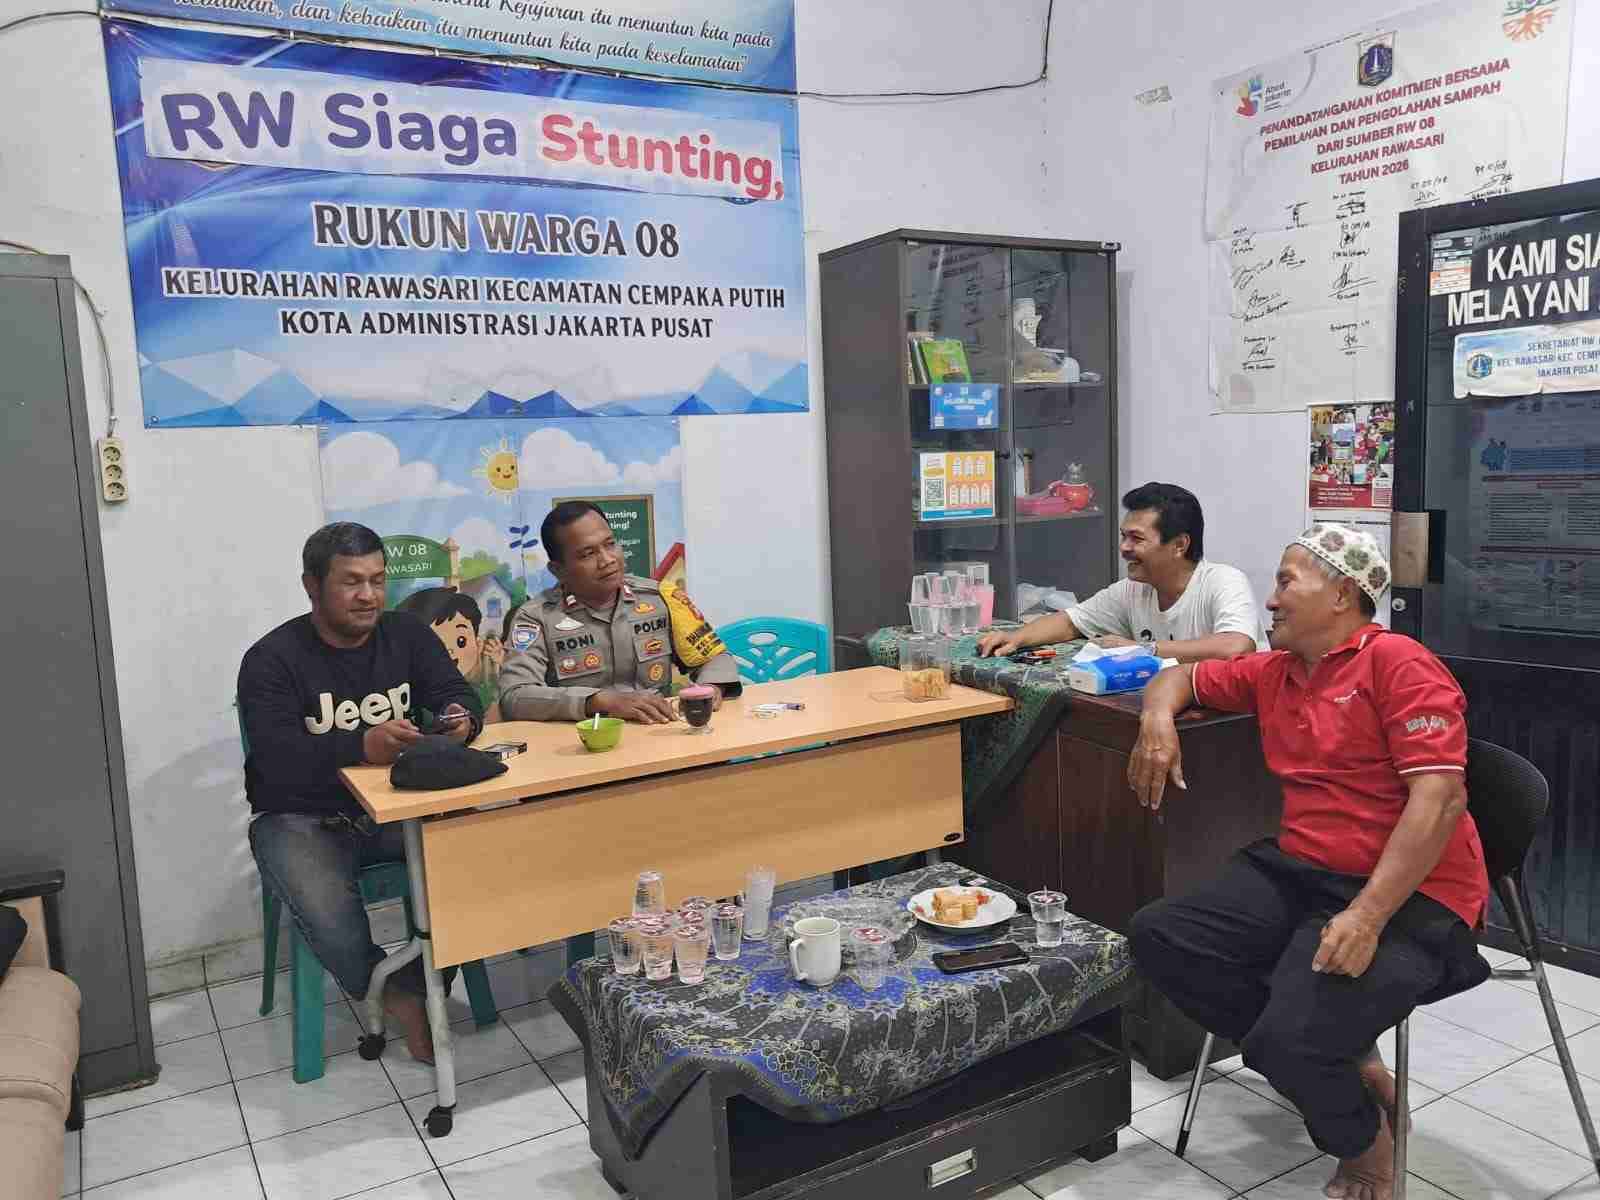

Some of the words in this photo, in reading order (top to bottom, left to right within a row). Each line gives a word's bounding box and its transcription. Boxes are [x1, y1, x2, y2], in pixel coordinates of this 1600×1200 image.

[291, 2, 332, 21] dan
[336, 2, 428, 32] kebaikan
[434, 17, 459, 37] itu
[466, 24, 552, 49] menuntun
[559, 31, 592, 53] kita
[595, 41, 639, 60] pada
[590, 7, 612, 26] itu
[617, 14, 696, 37] menuntun
[699, 18, 730, 41] kita
[732, 30, 772, 48] pada
[1260, 94, 1373, 137] PENANDATANGANAN
[1375, 76, 1442, 104] KOMITMEN
[1444, 57, 1511, 86] BERSAMA
[1264, 125, 1328, 152] PEMILAHAN
[1330, 116, 1356, 134] DAN
[1357, 95, 1442, 127] PENGOLAHAN
[1443, 79, 1502, 106] SAMPAH
[160, 89, 296, 152] RW
[323, 92, 518, 166] Siaga
[541, 113, 785, 200] Stunting,
[1311, 148, 1380, 175] KELURAHAN
[1381, 133, 1445, 159] RAWASARI
[1316, 139, 1344, 155] DARI
[1345, 126, 1395, 148] SUMBER
[1395, 120, 1417, 136] RW
[1418, 116, 1436, 131] 08
[1339, 167, 1380, 185] TAHUN
[1381, 159, 1410, 177] 2026
[313, 203, 469, 250] RUKUN
[478, 211, 627, 257] WARGA
[634, 220, 680, 259] 08
[1486, 238, 1557, 283] KAMI
[163, 269, 338, 299] KELURAHAN
[345, 275, 479, 302] RAWASARI
[486, 279, 622, 305] KECAMATAN
[627, 284, 724, 307] CEMPAKA
[729, 287, 786, 309] PUTIH
[1447, 275, 1590, 327] MELAYANI
[280, 310, 353, 335] KOTA
[360, 311, 538, 337] ADMINISTRASI
[544, 315, 646, 338] JAKARTA
[651, 317, 713, 338] PUSAT
[1527, 335, 1579, 352] SEKRETARIAT
[1536, 366, 1571, 378] JAKARTA
[1573, 363, 1599, 375] PUSAT
[604, 509, 638, 521] tunting
[609, 519, 630, 531] ting!
[385, 544, 404, 559] W
[408, 543, 427, 556] 08
[385, 559, 432, 575] WASARI
[555, 632, 596, 652] RONI
[634, 616, 667, 635] POLRI
[303, 681, 411, 736] Jeep
